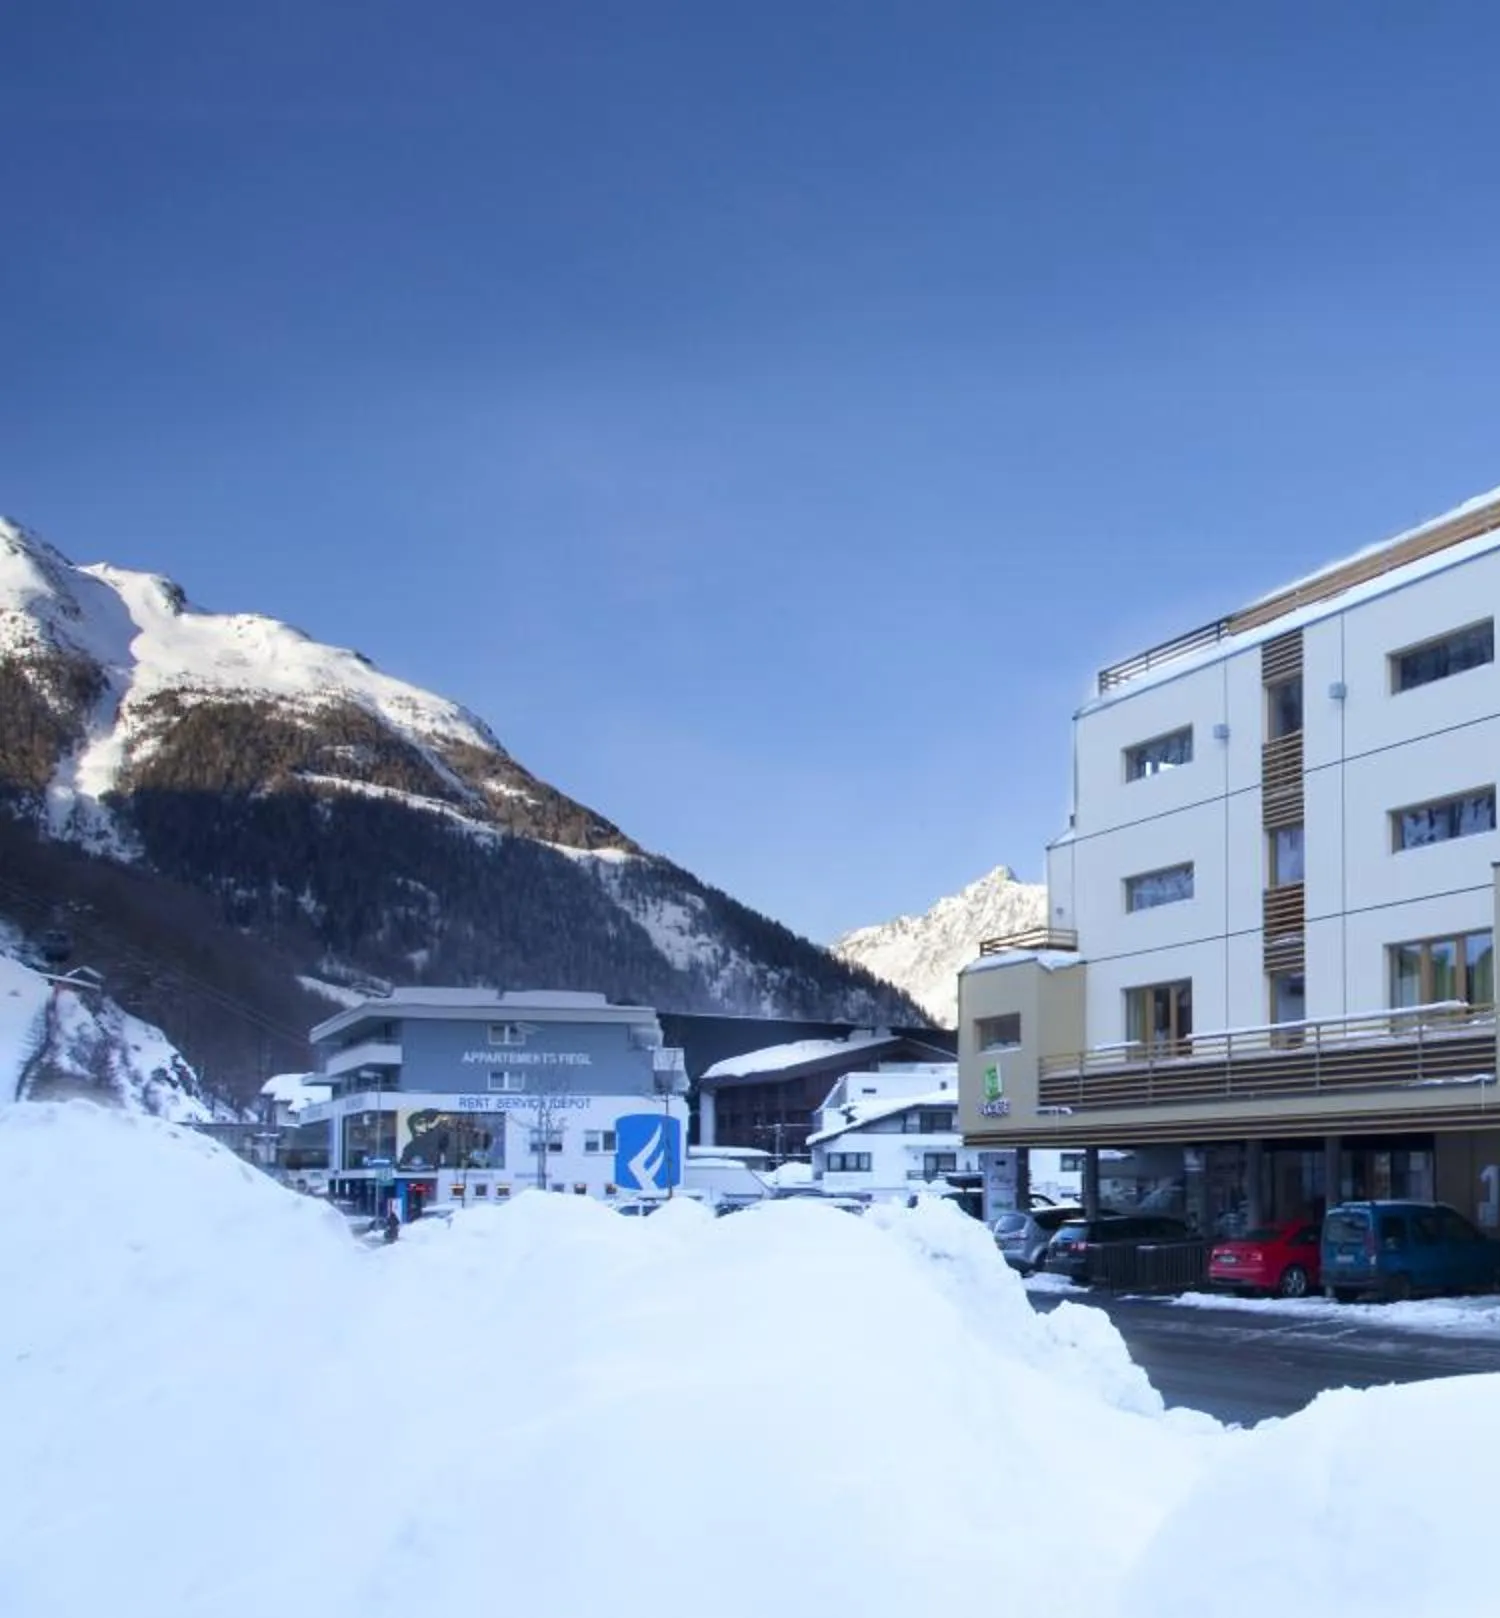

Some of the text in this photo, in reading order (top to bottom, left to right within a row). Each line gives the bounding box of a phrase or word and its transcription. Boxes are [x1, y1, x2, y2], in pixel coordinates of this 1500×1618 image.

[461, 1051, 592, 1066] APPARTEMENTS FIEGL
[459, 1097, 489, 1109] RENT
